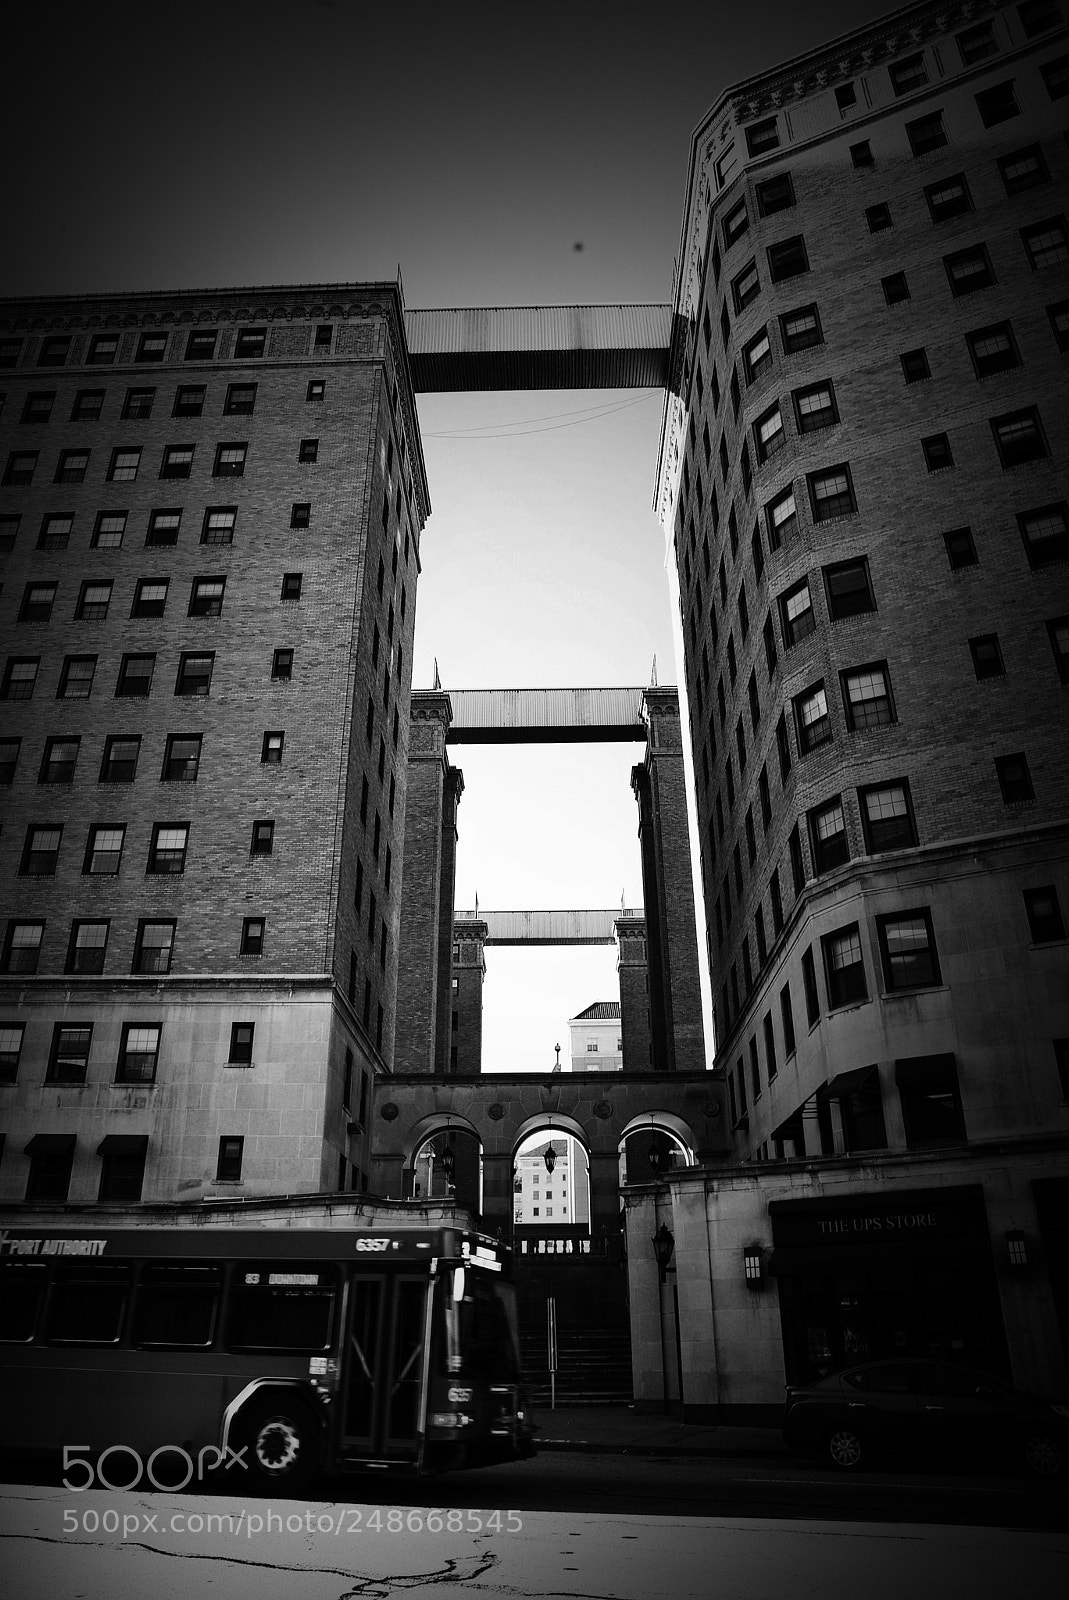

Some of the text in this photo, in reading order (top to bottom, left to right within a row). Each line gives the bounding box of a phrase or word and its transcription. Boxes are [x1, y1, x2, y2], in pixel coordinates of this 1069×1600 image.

[818, 1212, 937, 1233] THE UPS STORE
[9, 1239, 108, 1256] PORT AUTHORITY
[355, 1238, 391, 1252] 6357
